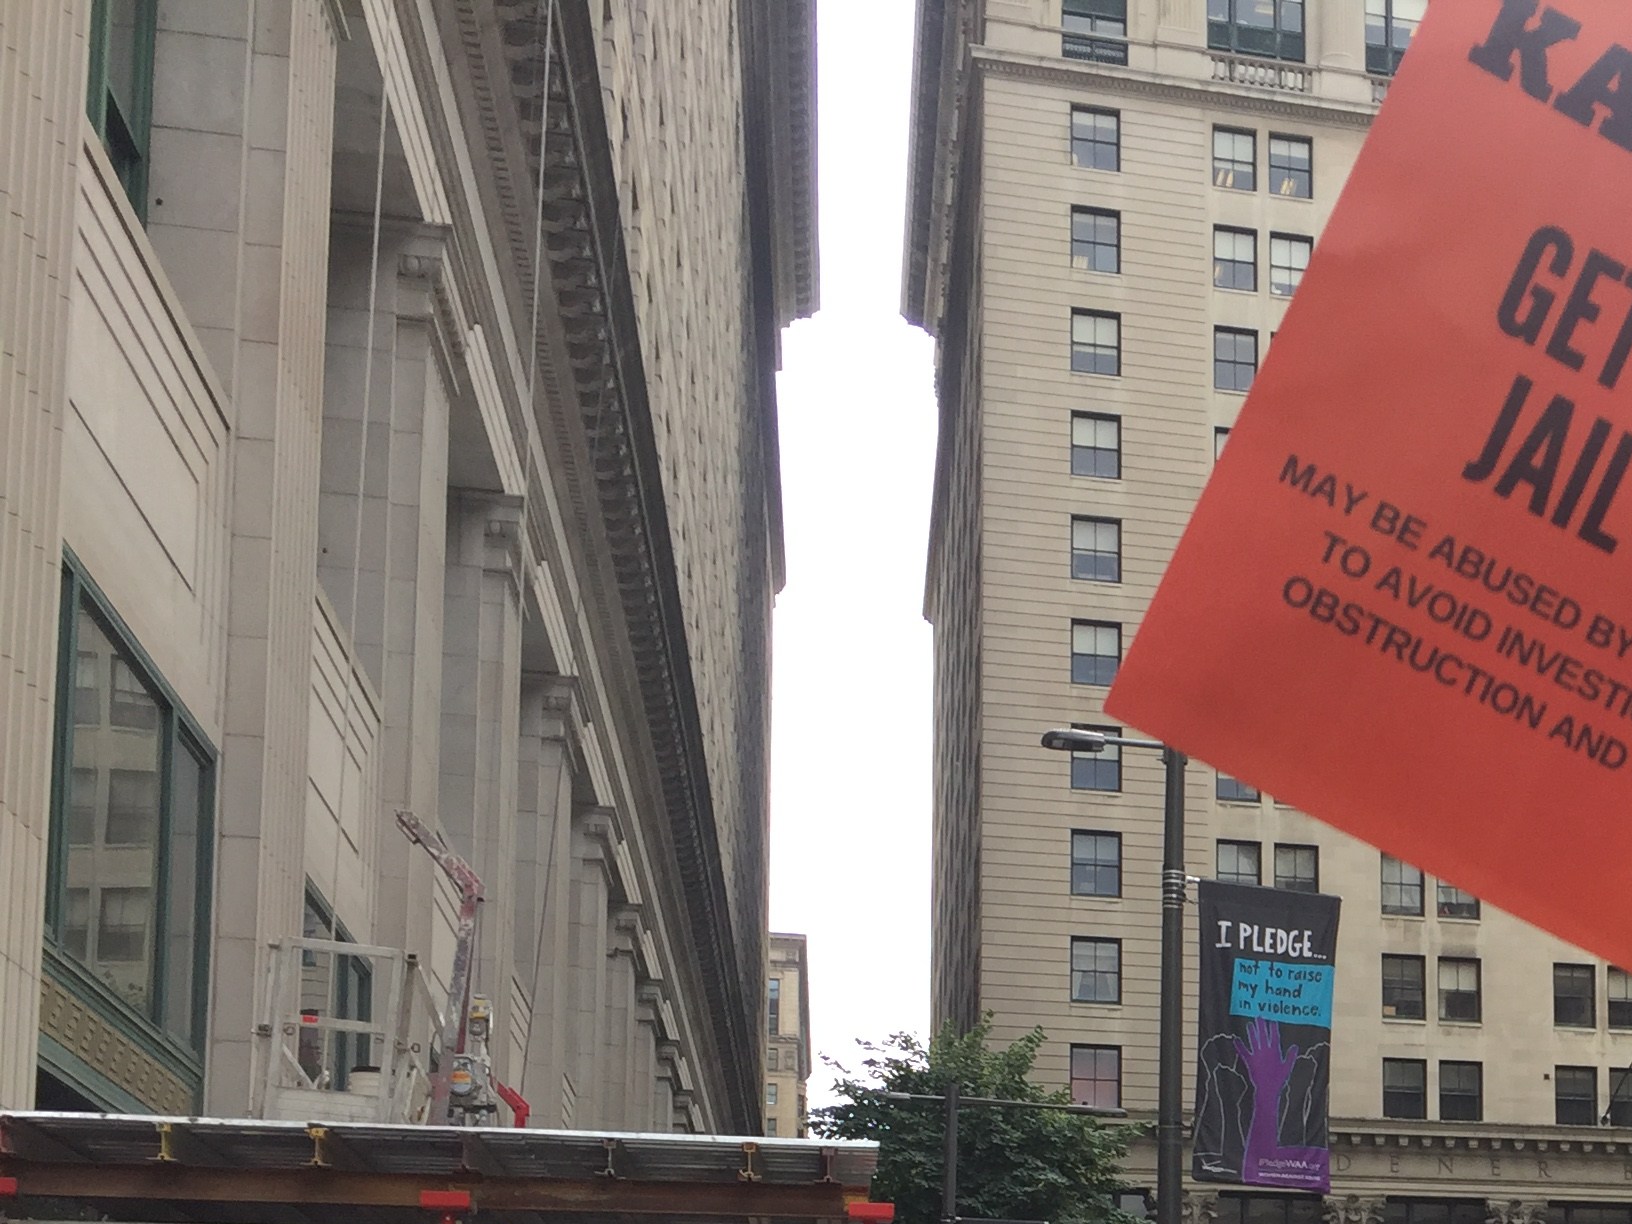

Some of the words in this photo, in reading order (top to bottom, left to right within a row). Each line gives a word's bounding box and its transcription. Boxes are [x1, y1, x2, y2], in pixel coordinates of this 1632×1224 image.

[1279, 454, 1369, 515] MAY
[1370, 500, 1427, 550] BE
[1428, 535, 1582, 629] ABUSED
[1322, 530, 1371, 578] TO
[1375, 566, 1493, 641] AVOID
[1282, 575, 1547, 729] OBSTRUCTION
[1549, 714, 1628, 770] AND
[1215, 920, 1232, 948] I
[1239, 923, 1327, 960] PLEDGE...
[1238, 981, 1258, 998] my
[1265, 979, 1302, 998] hand
[1239, 962, 1260, 976] not
[1269, 962, 1282, 978] to
[1288, 967, 1322, 983] raise
[1239, 999, 1251, 1010] in
[1258, 1001, 1321, 1017] violence.
[1335, 1154, 1552, 1179] DENER
